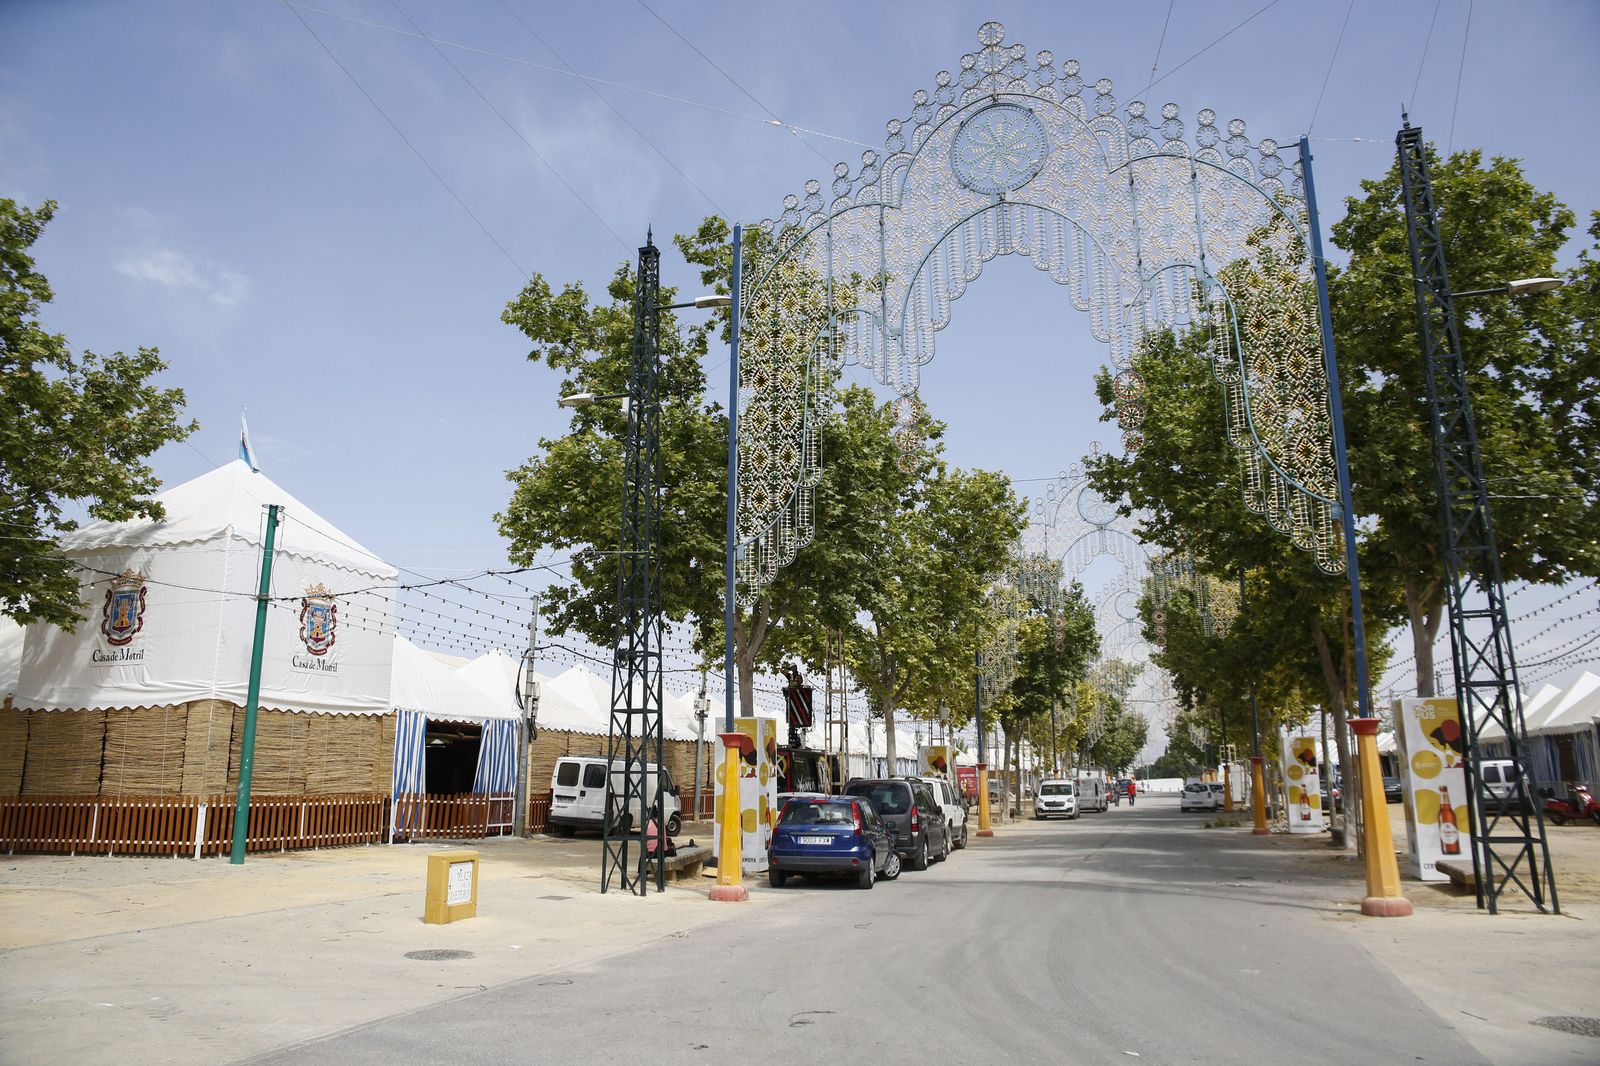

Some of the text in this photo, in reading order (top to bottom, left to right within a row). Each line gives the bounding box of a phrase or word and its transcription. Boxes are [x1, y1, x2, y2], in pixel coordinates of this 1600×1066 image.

[92, 648, 145, 662] Casa de Motril
[292, 655, 338, 672] Casa de Motril
